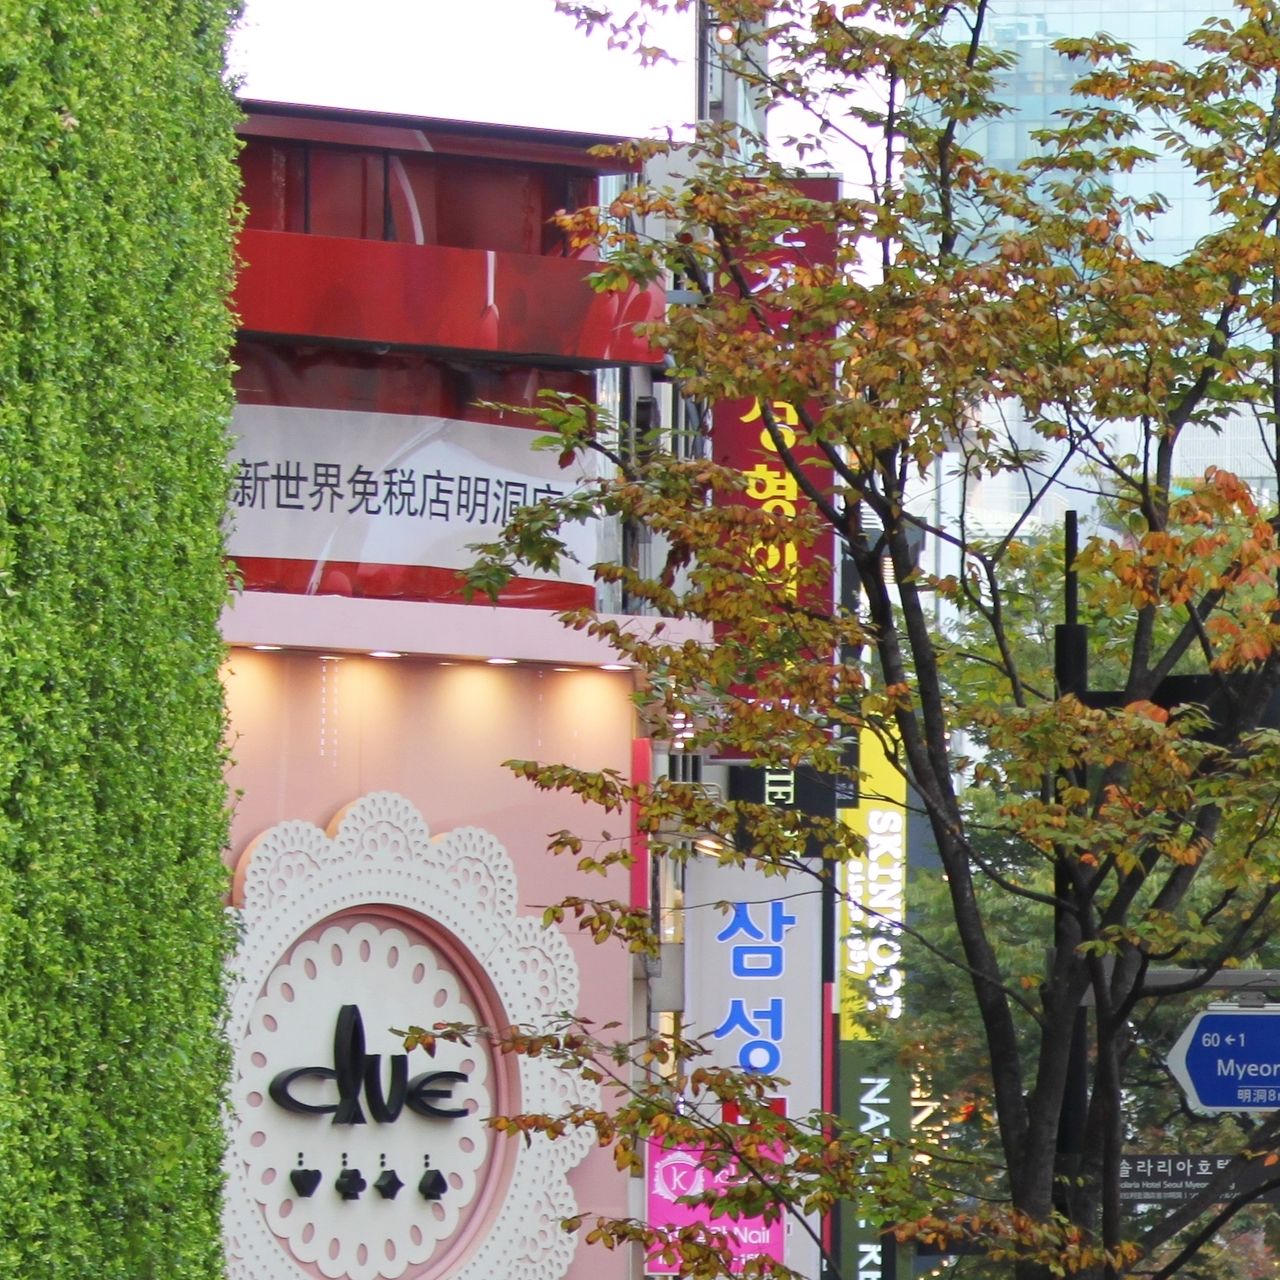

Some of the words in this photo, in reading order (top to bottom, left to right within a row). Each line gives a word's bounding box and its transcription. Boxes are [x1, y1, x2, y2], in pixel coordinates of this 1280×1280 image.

[715, 900, 798, 1077] 삼성
[1202, 1034, 1221, 1047] 60
[734, 1227, 770, 1244] Nail
